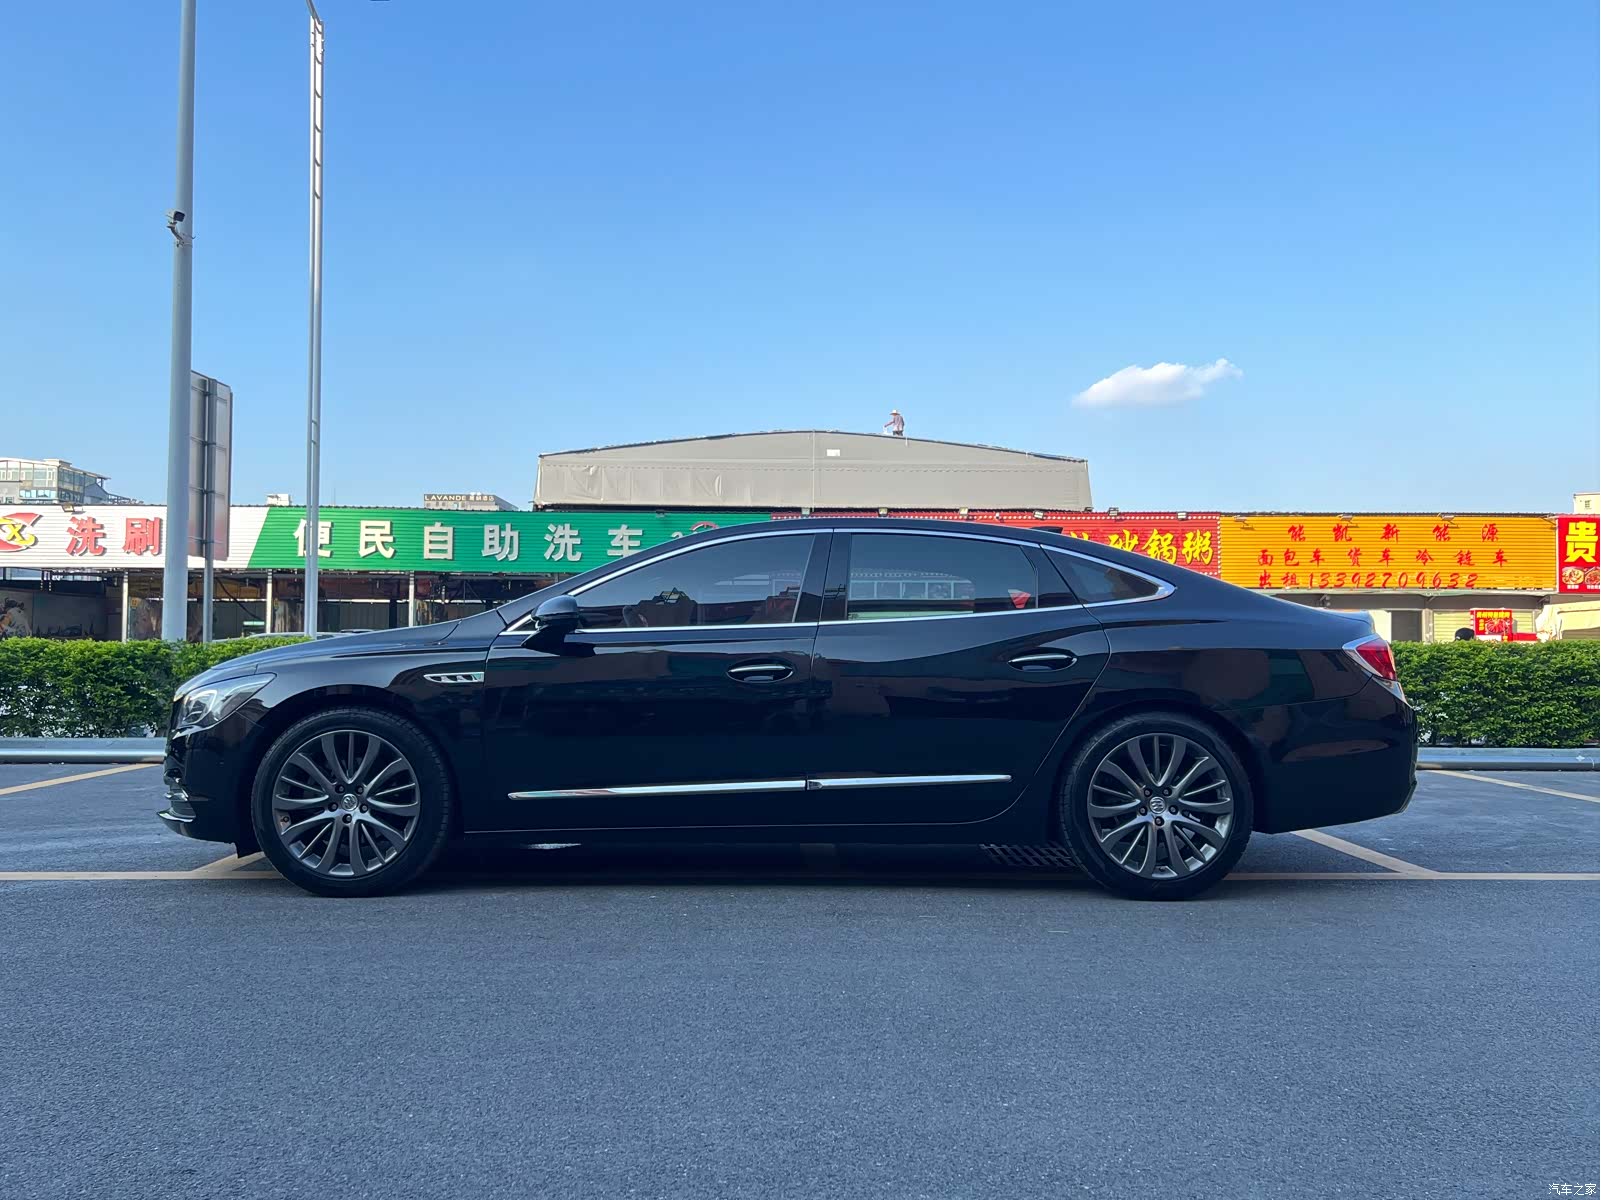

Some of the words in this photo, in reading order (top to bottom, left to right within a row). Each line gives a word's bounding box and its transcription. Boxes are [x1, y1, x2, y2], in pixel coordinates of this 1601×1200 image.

[65, 516, 163, 556] 洗刷
[293, 518, 643, 562] 便民自助洗车
[1069, 527, 1213, 565] 砂锅粥
[1563, 521, 1599, 563] 贵
